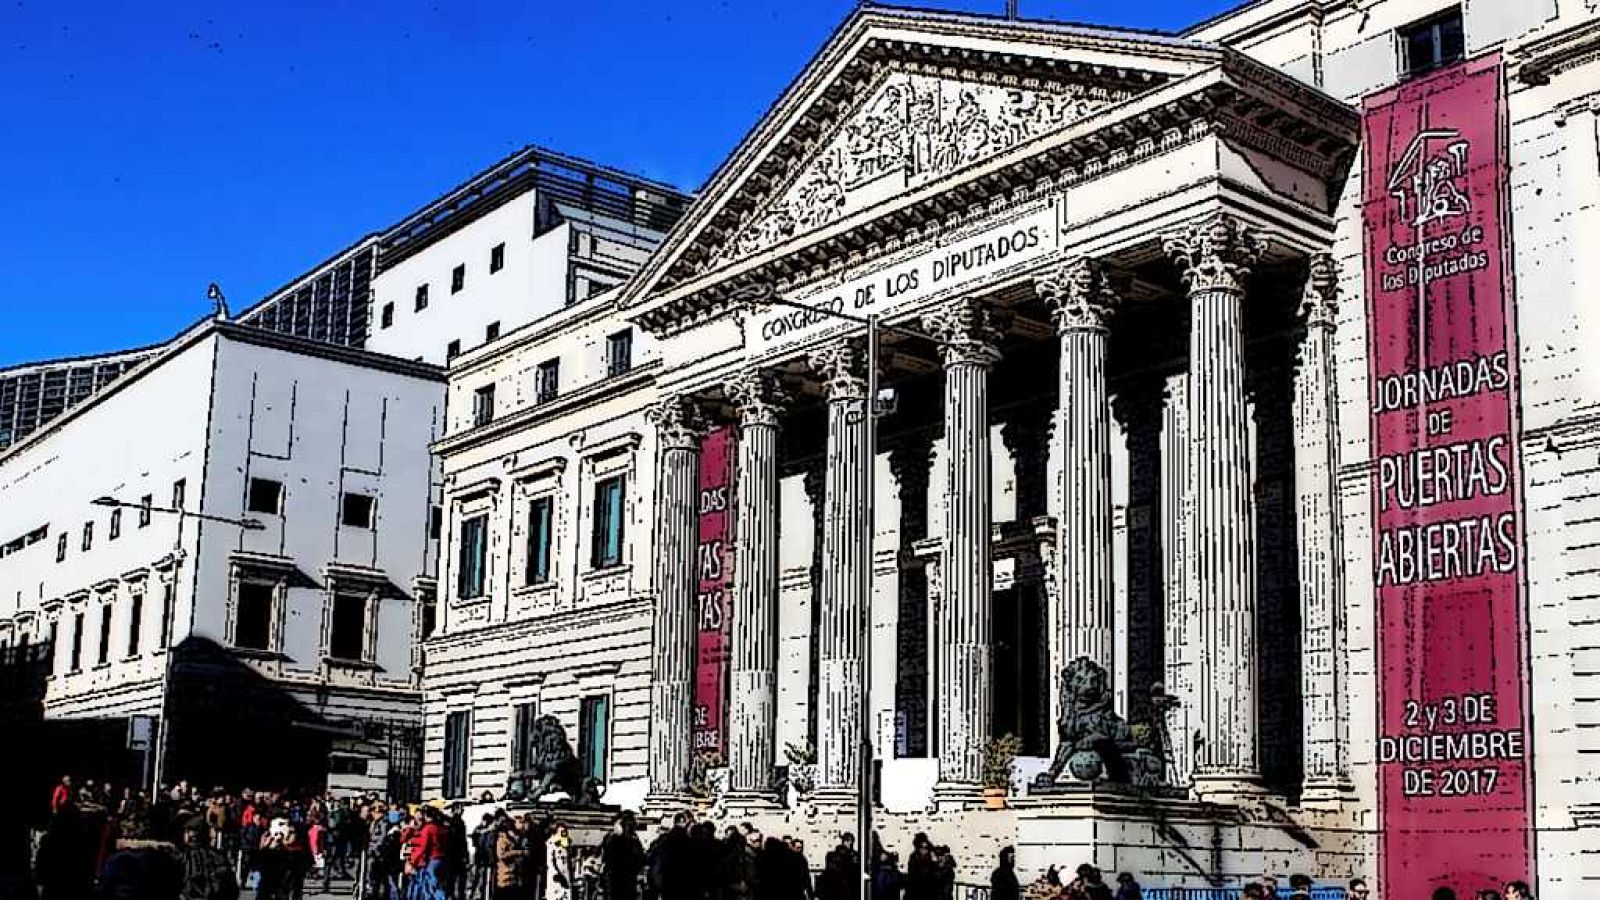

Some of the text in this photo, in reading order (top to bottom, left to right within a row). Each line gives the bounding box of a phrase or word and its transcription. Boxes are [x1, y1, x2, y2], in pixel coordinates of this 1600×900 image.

[1386, 227, 1482, 264] Congreso de
[762, 226, 1039, 341] CONGRESO DE LOS DIPUTADOS
[1383, 273, 1404, 290] los
[1373, 353, 1508, 413] JORNADAS
[1429, 412, 1450, 435] DE
[1380, 437, 1507, 511] PUERTAS
[1377, 513, 1515, 586] ABIERTAS
[1406, 695, 1493, 730] 2 y 3 DE
[1380, 732, 1523, 762] DICIEMBRE
[1404, 769, 1498, 795] DE 2017
